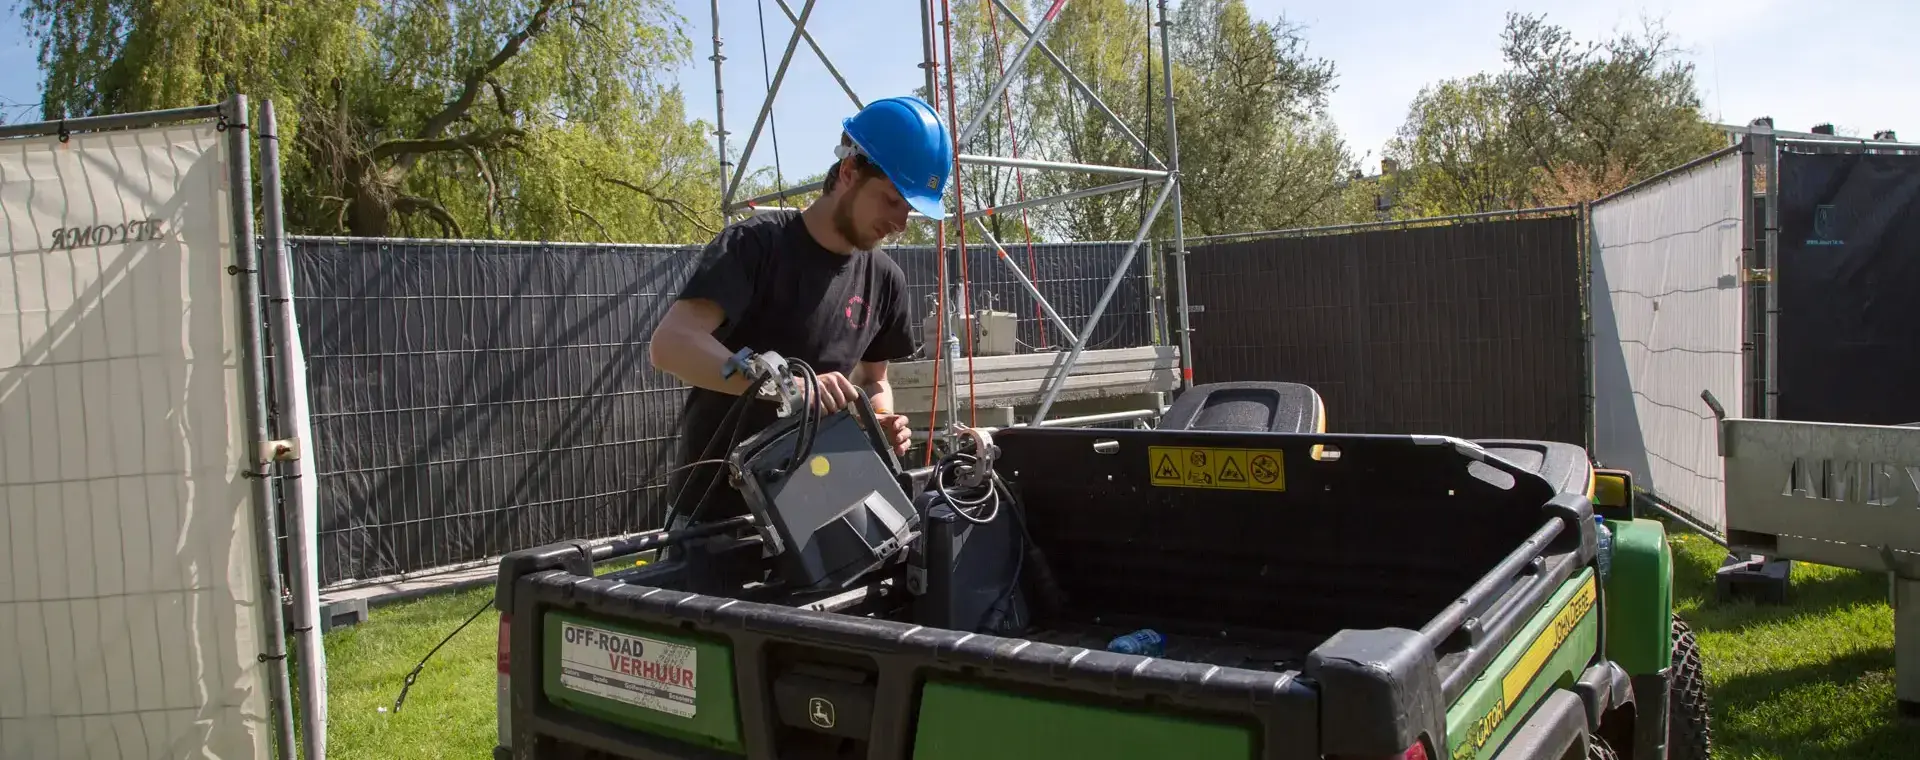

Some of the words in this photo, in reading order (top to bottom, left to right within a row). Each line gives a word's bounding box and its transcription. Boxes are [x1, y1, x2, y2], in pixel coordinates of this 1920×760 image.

[49, 217, 165, 252] AMDYTE
[564, 627, 644, 657] OFF-ROAD
[609, 653, 694, 688] VERHUUR
[1476, 698, 1504, 751] GATOR
